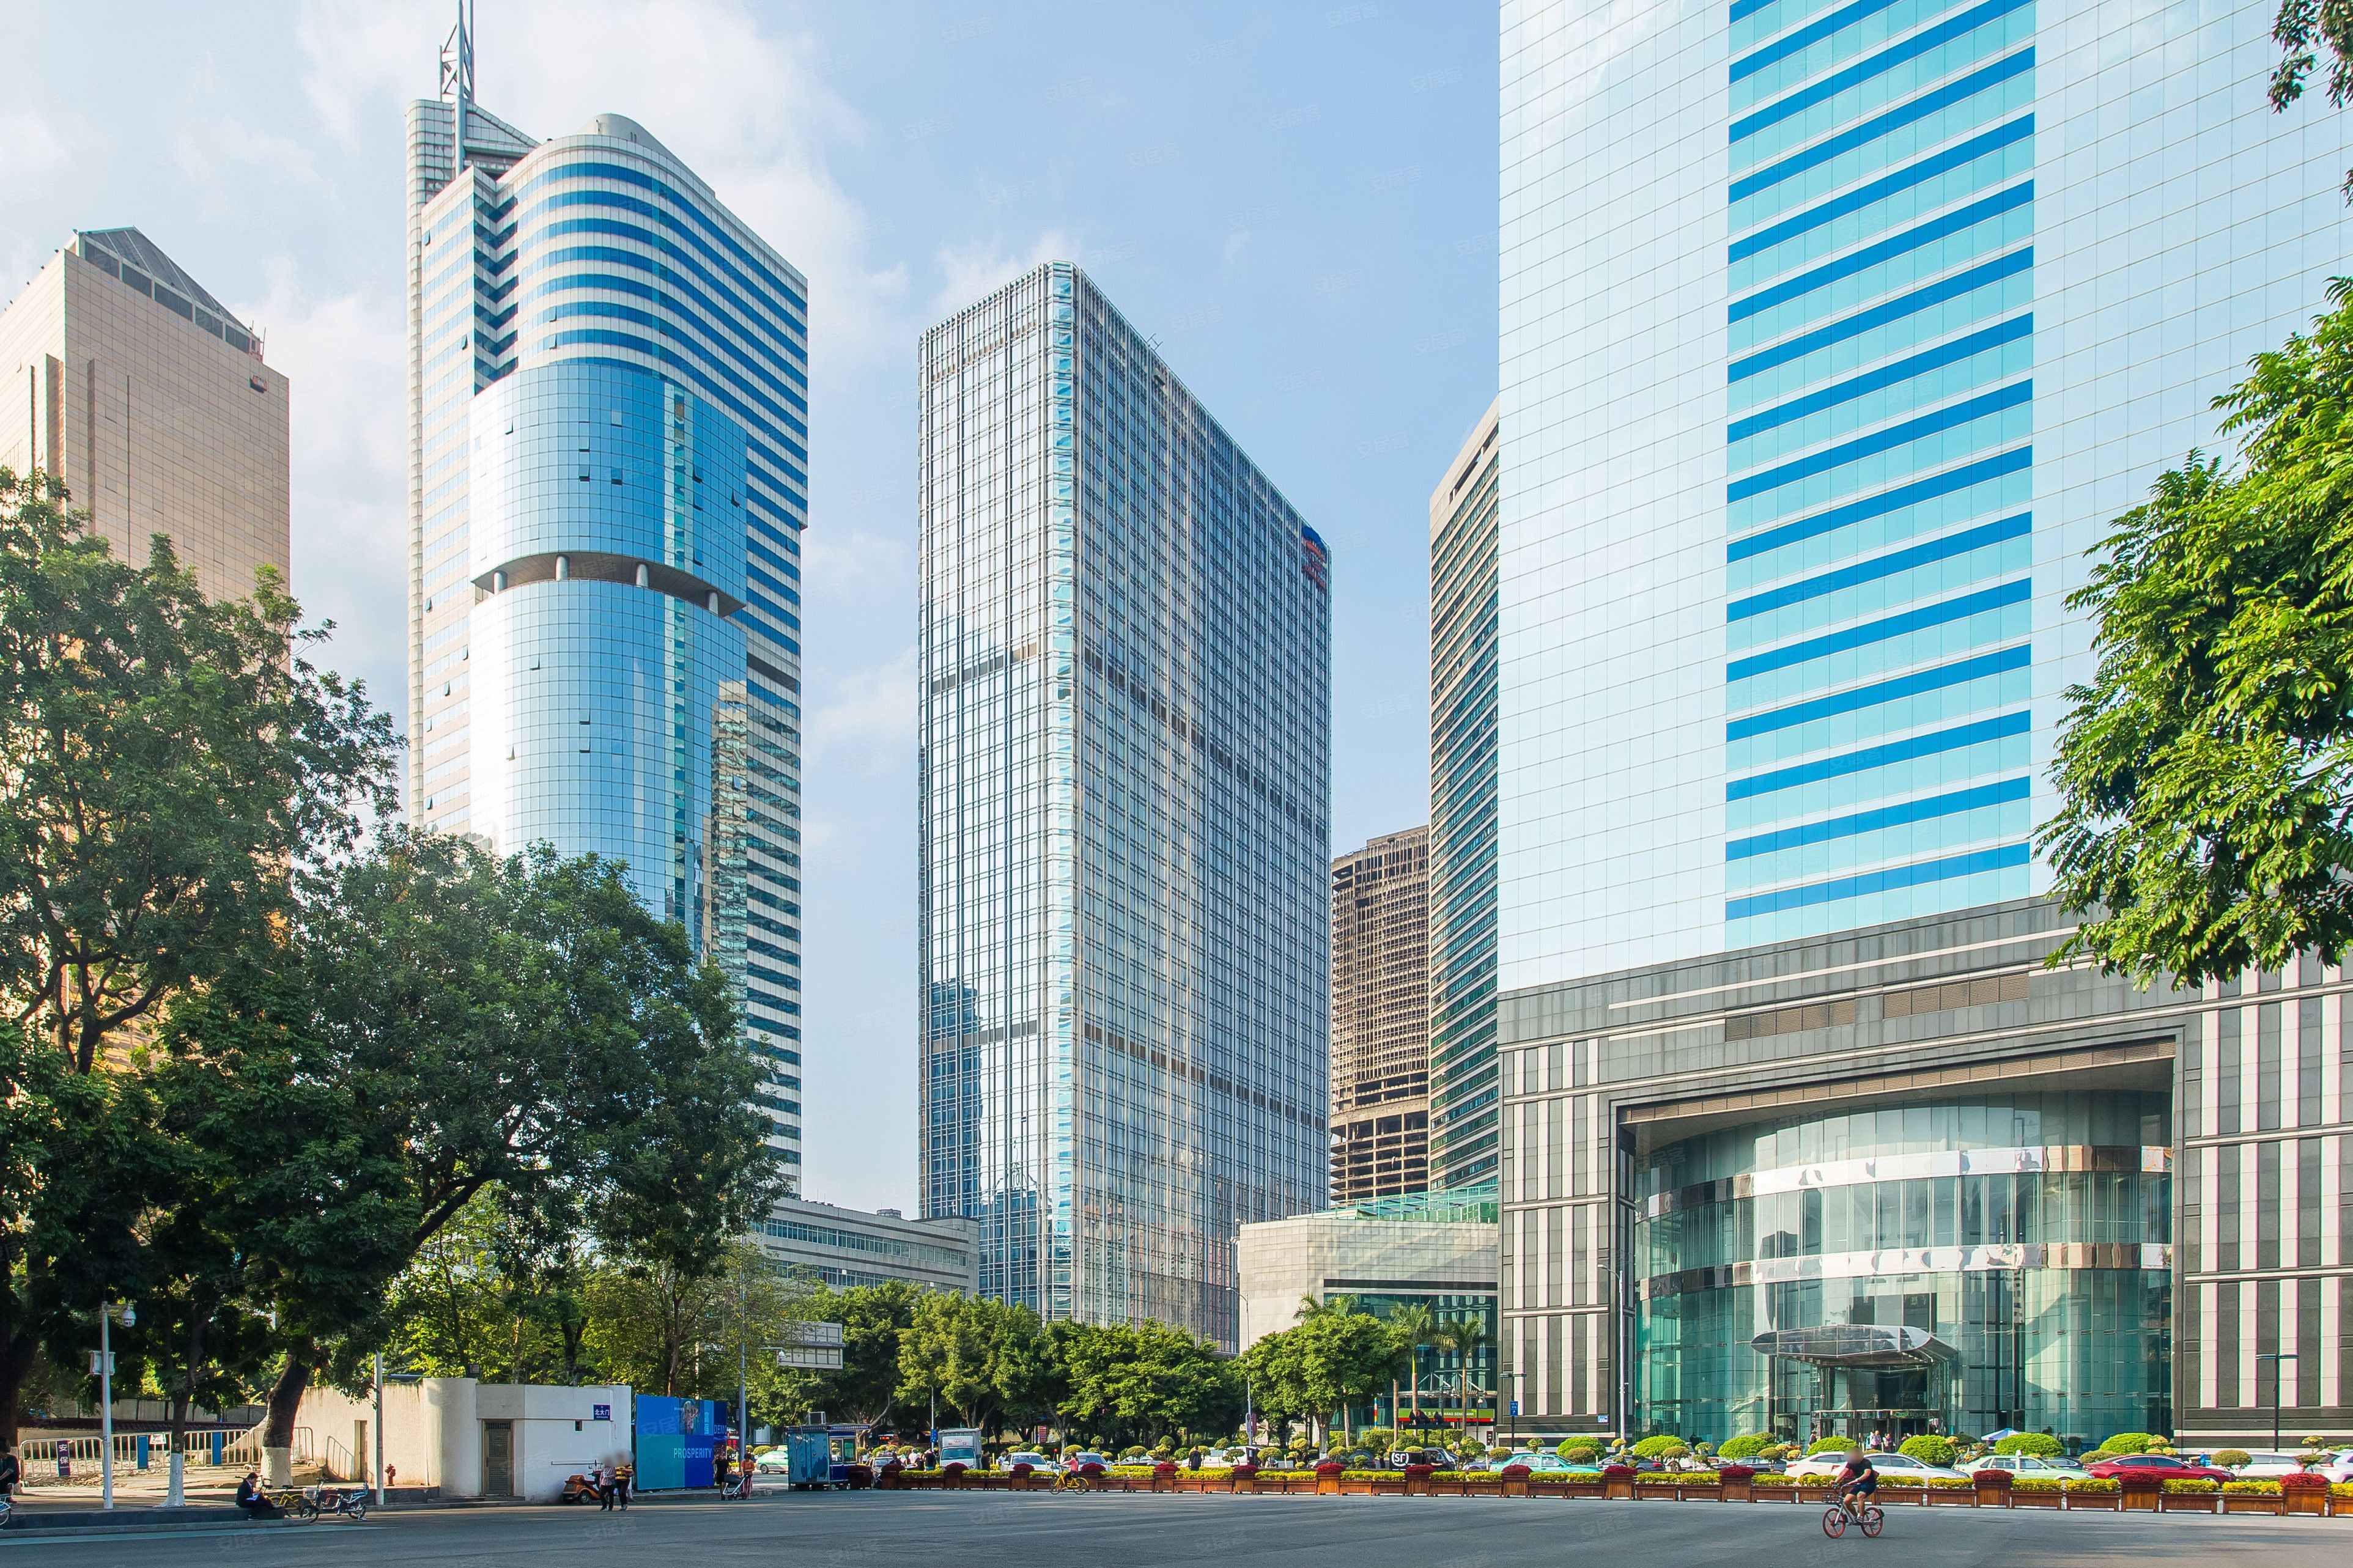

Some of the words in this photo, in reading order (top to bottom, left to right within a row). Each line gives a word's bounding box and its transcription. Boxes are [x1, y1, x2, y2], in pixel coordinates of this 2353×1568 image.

[59, 1443, 68, 1464] 安保
[673, 1448, 712, 1459] PROSPERITY
[1394, 1452, 1406, 1463] SF
